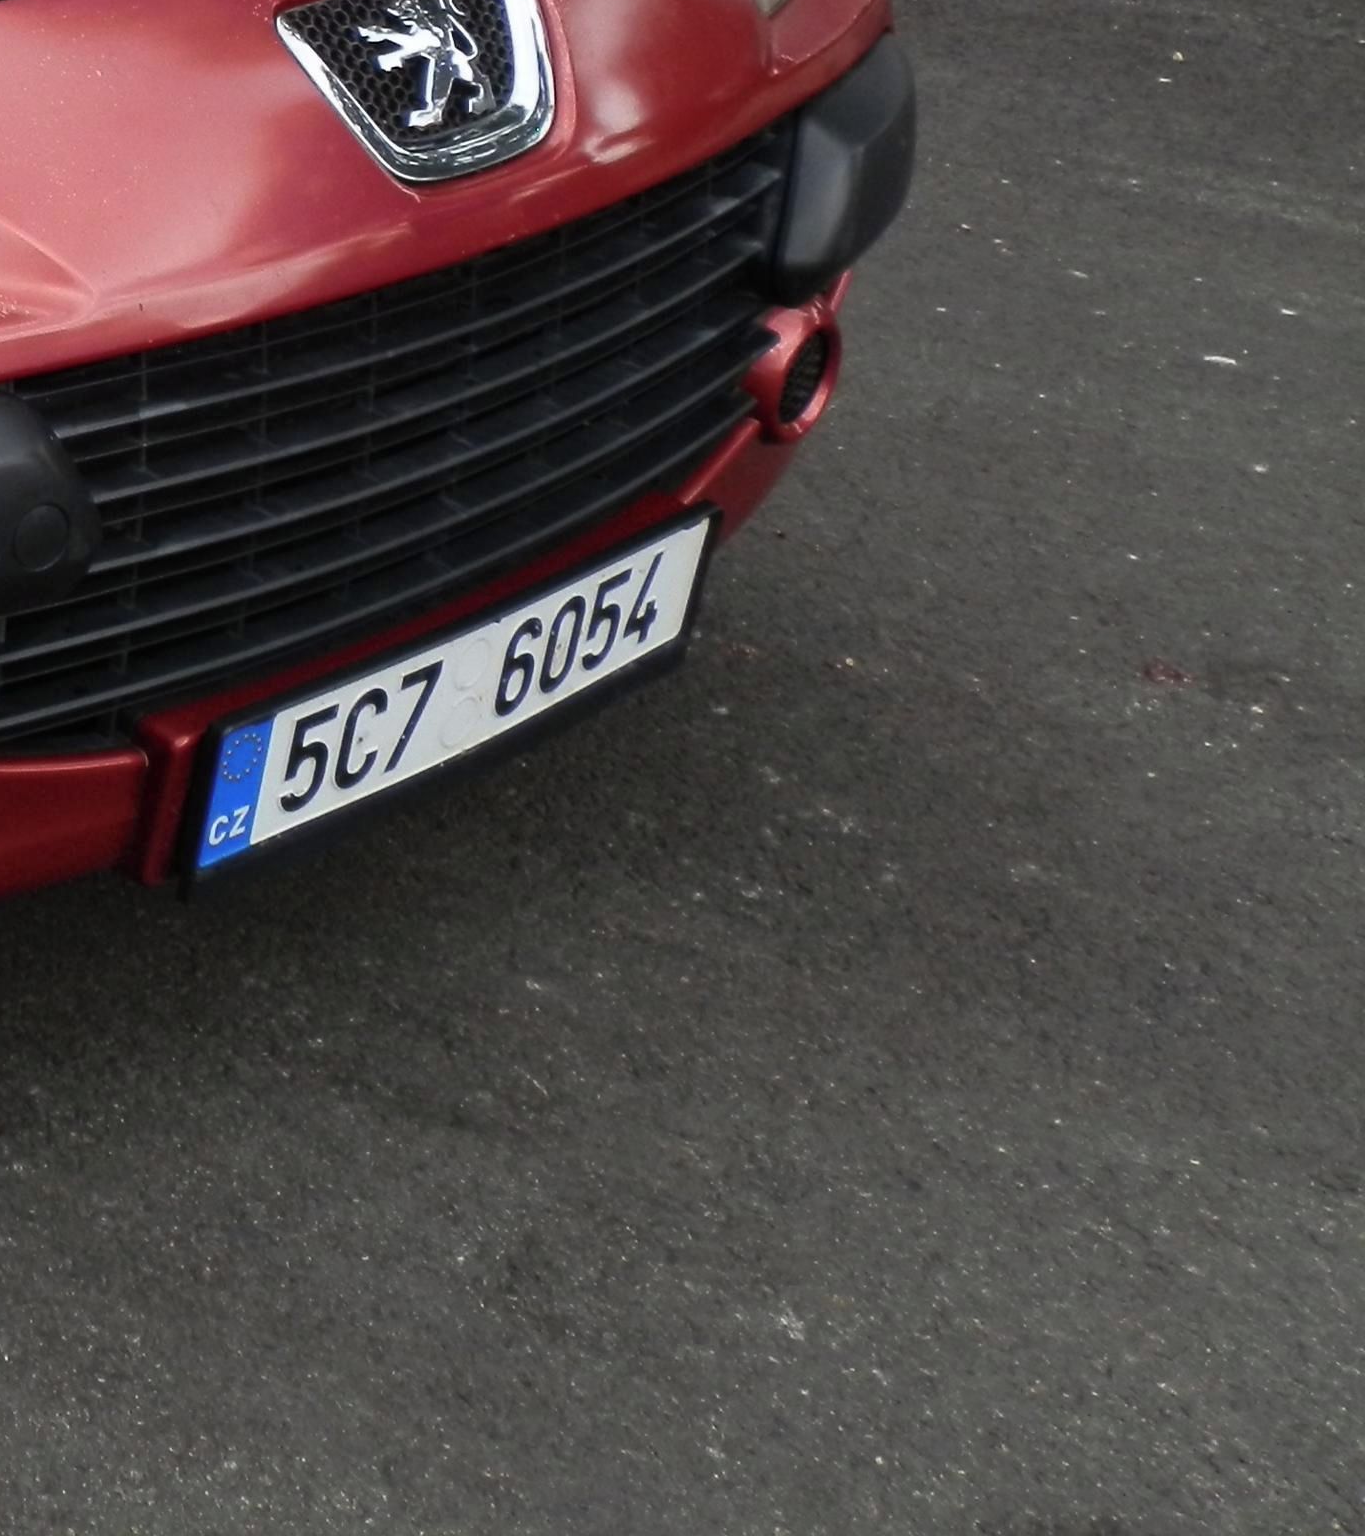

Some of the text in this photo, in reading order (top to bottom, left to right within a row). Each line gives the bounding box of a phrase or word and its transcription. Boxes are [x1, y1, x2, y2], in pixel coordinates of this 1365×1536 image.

[279, 552, 664, 812] 5C7 6054
[209, 805, 250, 845] CZ
